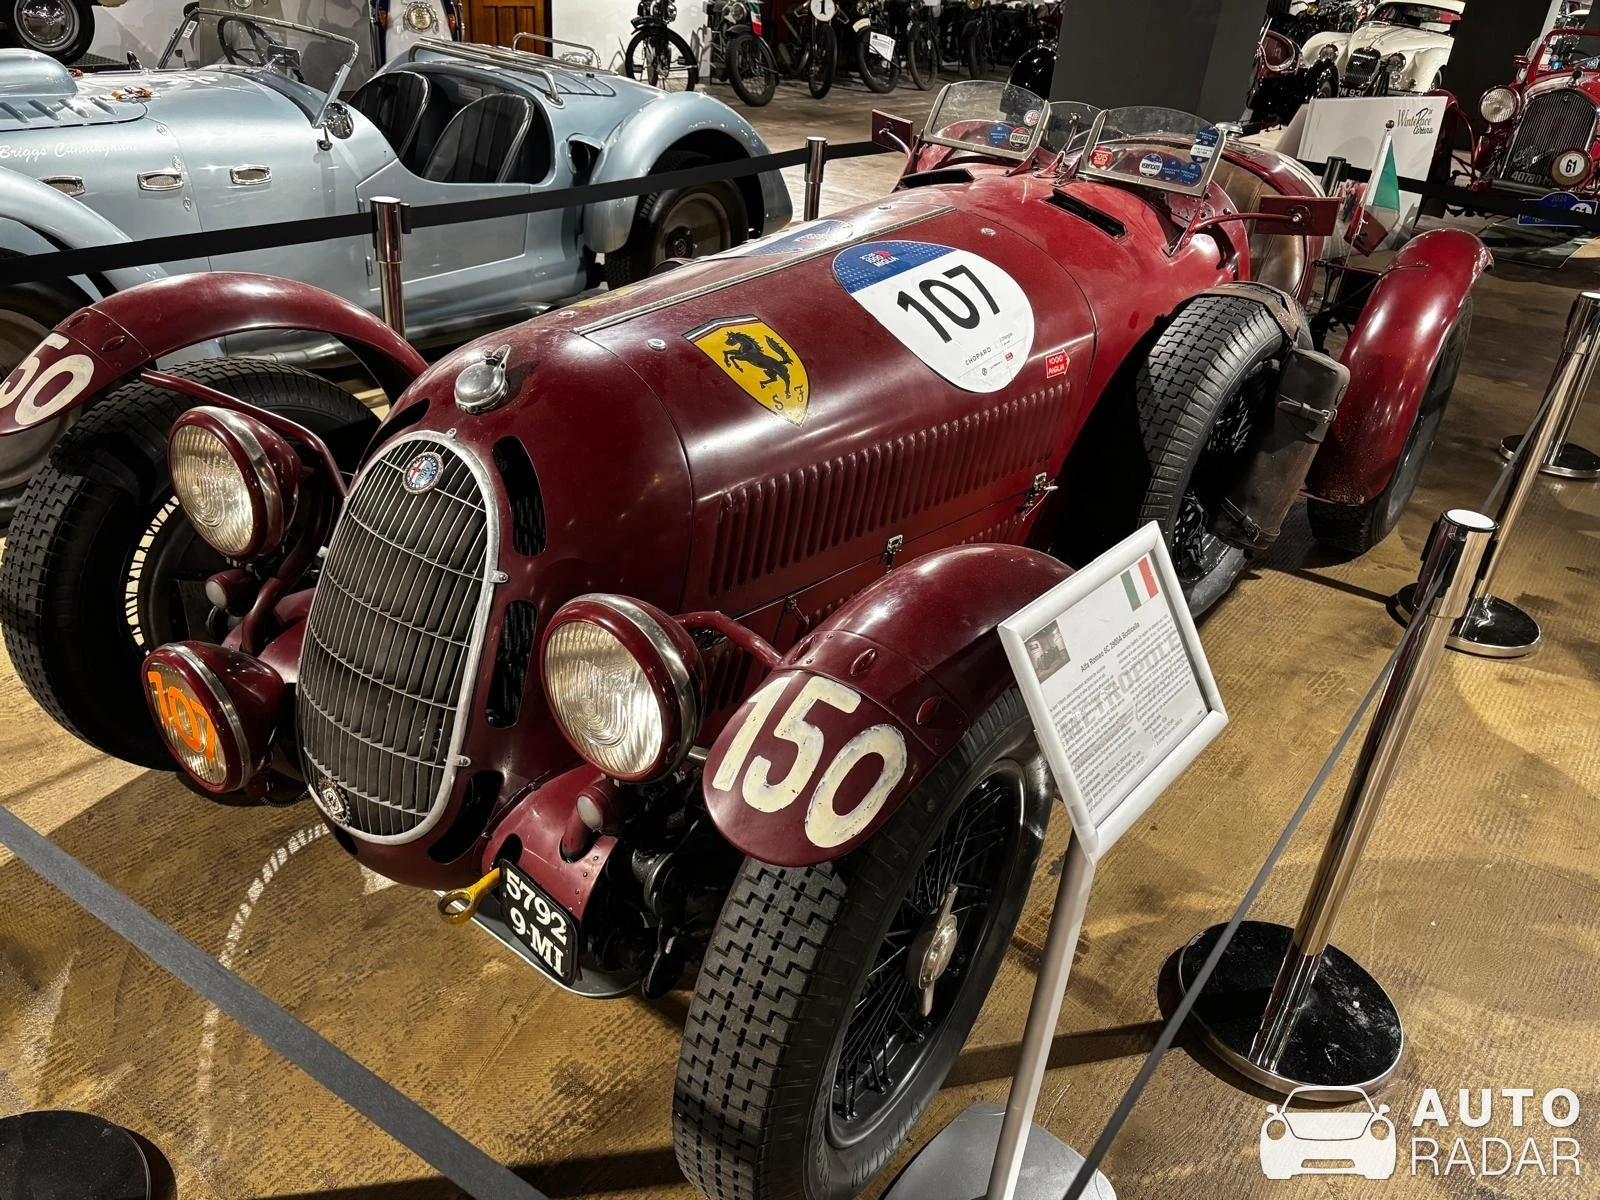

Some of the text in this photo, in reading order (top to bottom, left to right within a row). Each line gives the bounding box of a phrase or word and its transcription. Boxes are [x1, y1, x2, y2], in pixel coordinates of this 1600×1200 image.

[0, 144, 47, 162] Briggs
[1566, 159, 1578, 174] 61
[897, 264, 1000, 344] 107
[965, 346, 992, 366] CHOPARD
[1048, 354, 1064, 364] 1000
[1048, 364, 1064, 375] MIGLIA
[1088, 651, 1104, 666] Romeo
[148, 671, 216, 765] 107
[712, 676, 908, 848] 150
[506, 868, 568, 946] 5792
